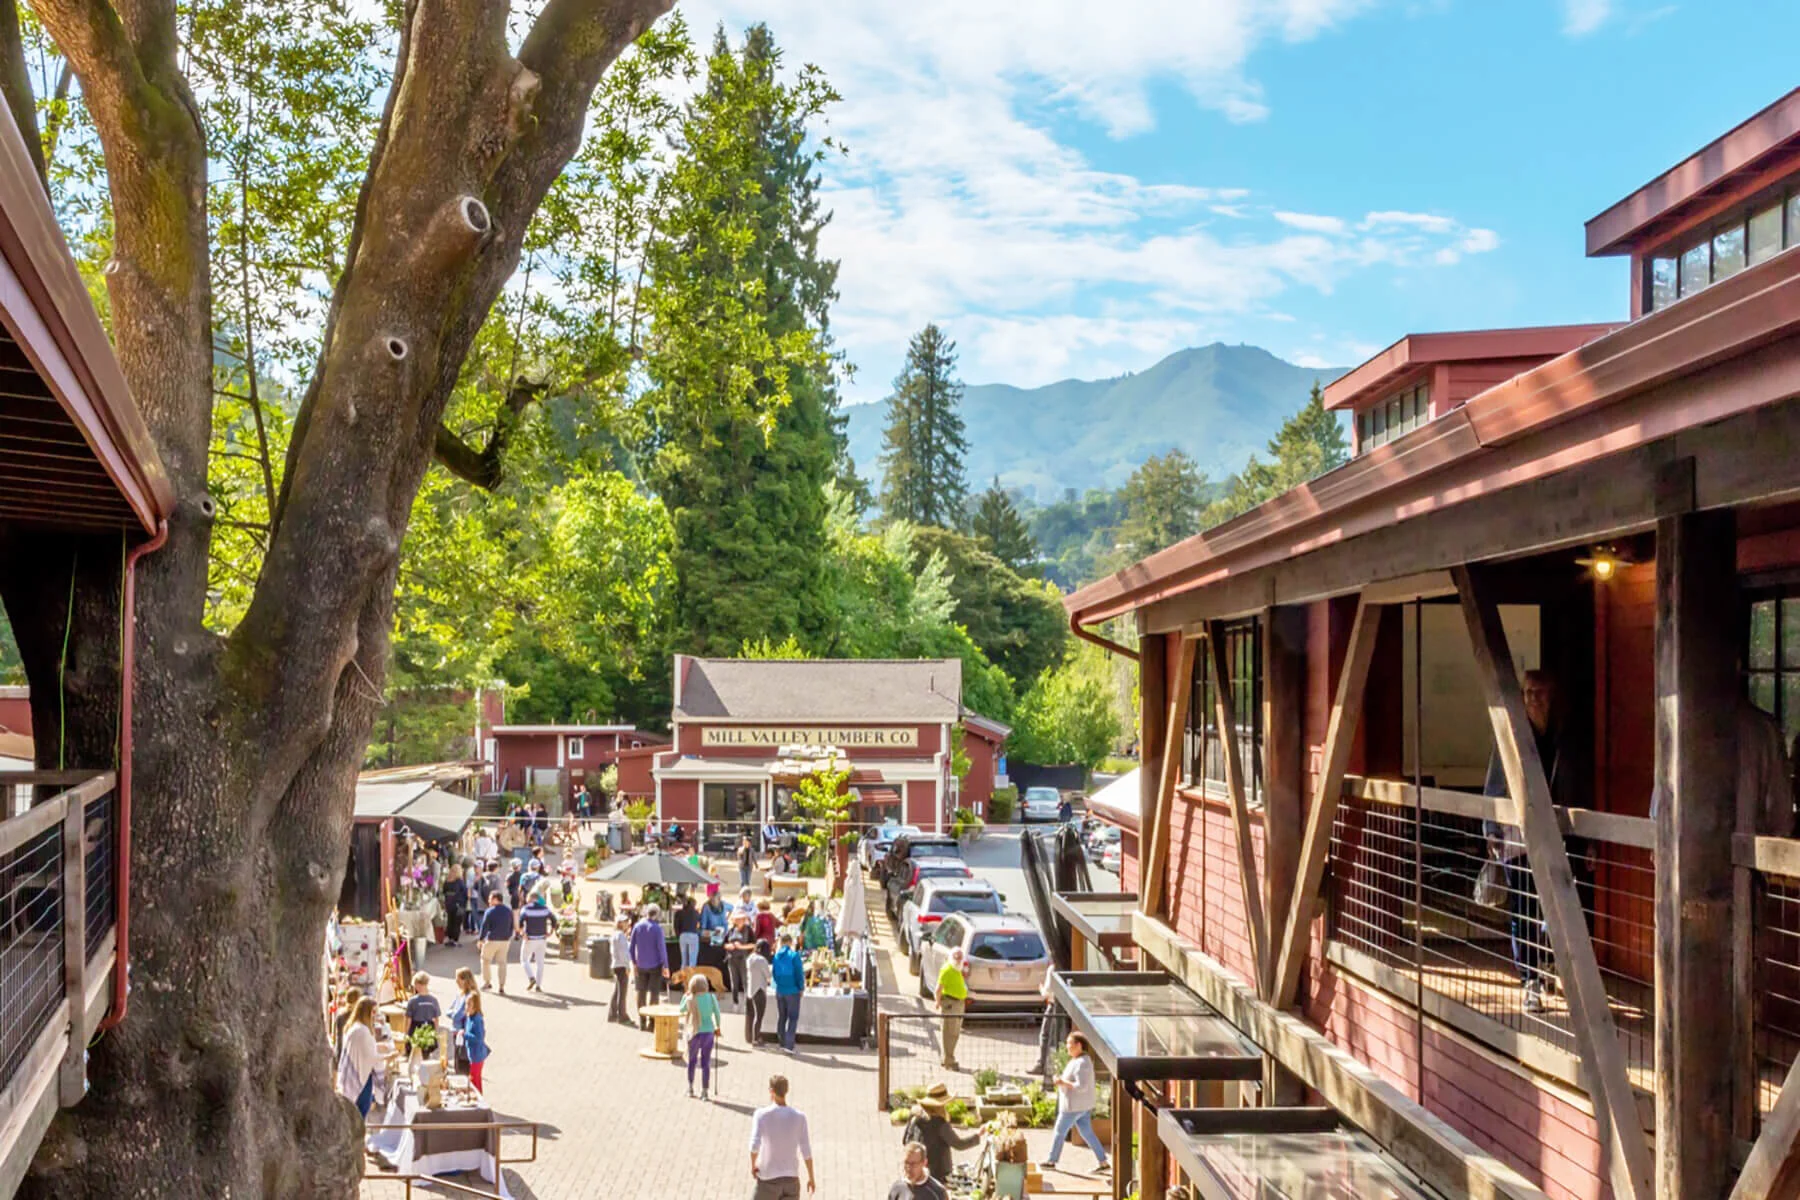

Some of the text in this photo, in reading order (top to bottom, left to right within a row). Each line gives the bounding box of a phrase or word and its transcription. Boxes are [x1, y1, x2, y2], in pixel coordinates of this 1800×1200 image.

[707, 730, 746, 744] MILL
[751, 730, 811, 744] VALLEY
[818, 730, 885, 744] LUMBER
